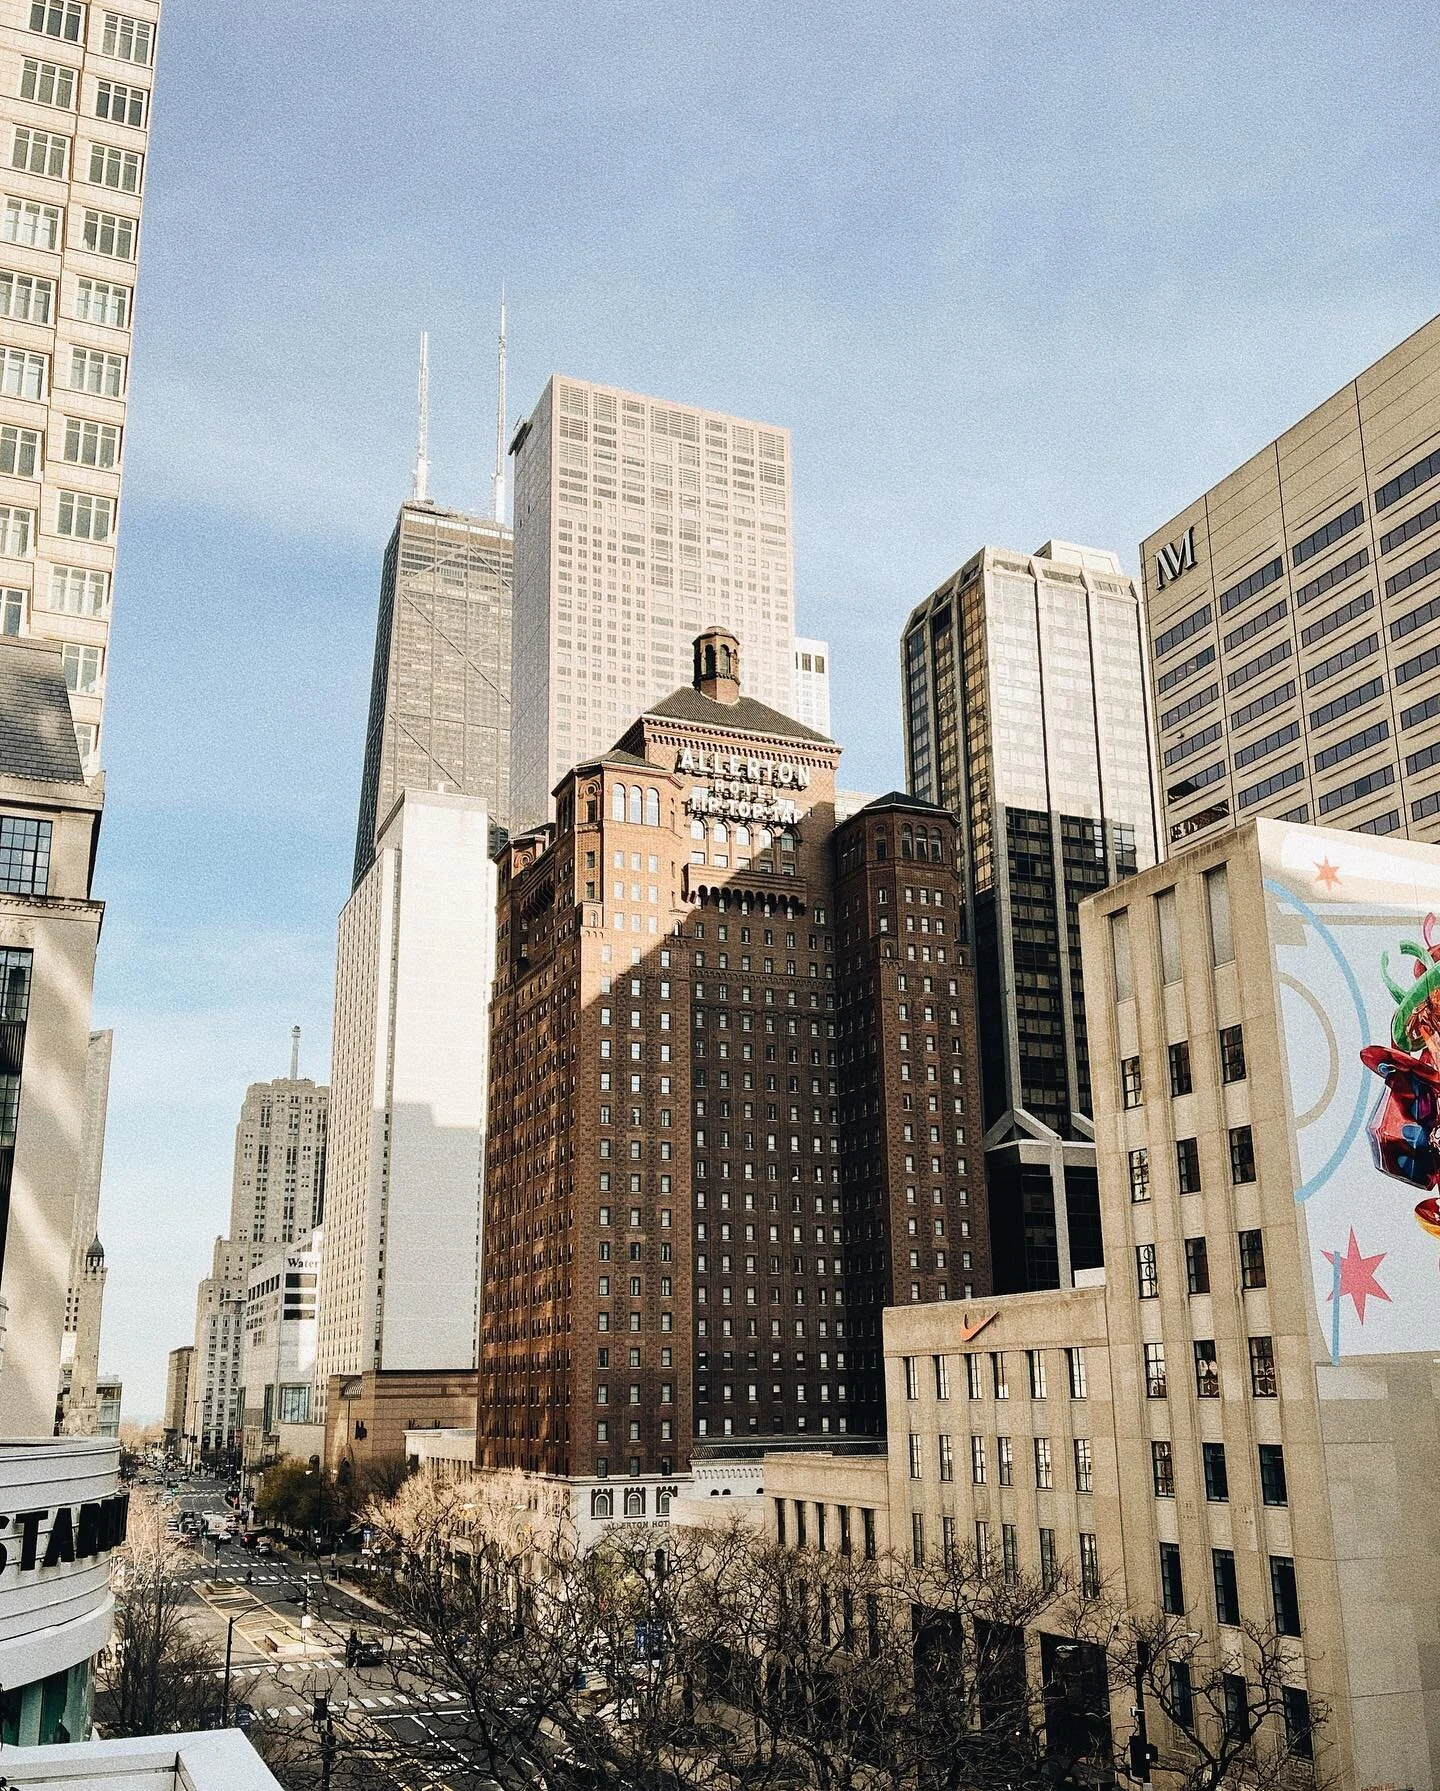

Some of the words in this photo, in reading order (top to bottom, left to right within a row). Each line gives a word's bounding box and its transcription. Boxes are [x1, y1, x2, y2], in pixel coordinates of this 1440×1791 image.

[680, 746, 810, 787] ALLERTON
[714, 780, 777, 801] HOTEL
[691, 795, 720, 814] TIP
[728, 799, 762, 819] TOP
[772, 805, 804, 824] TAP
